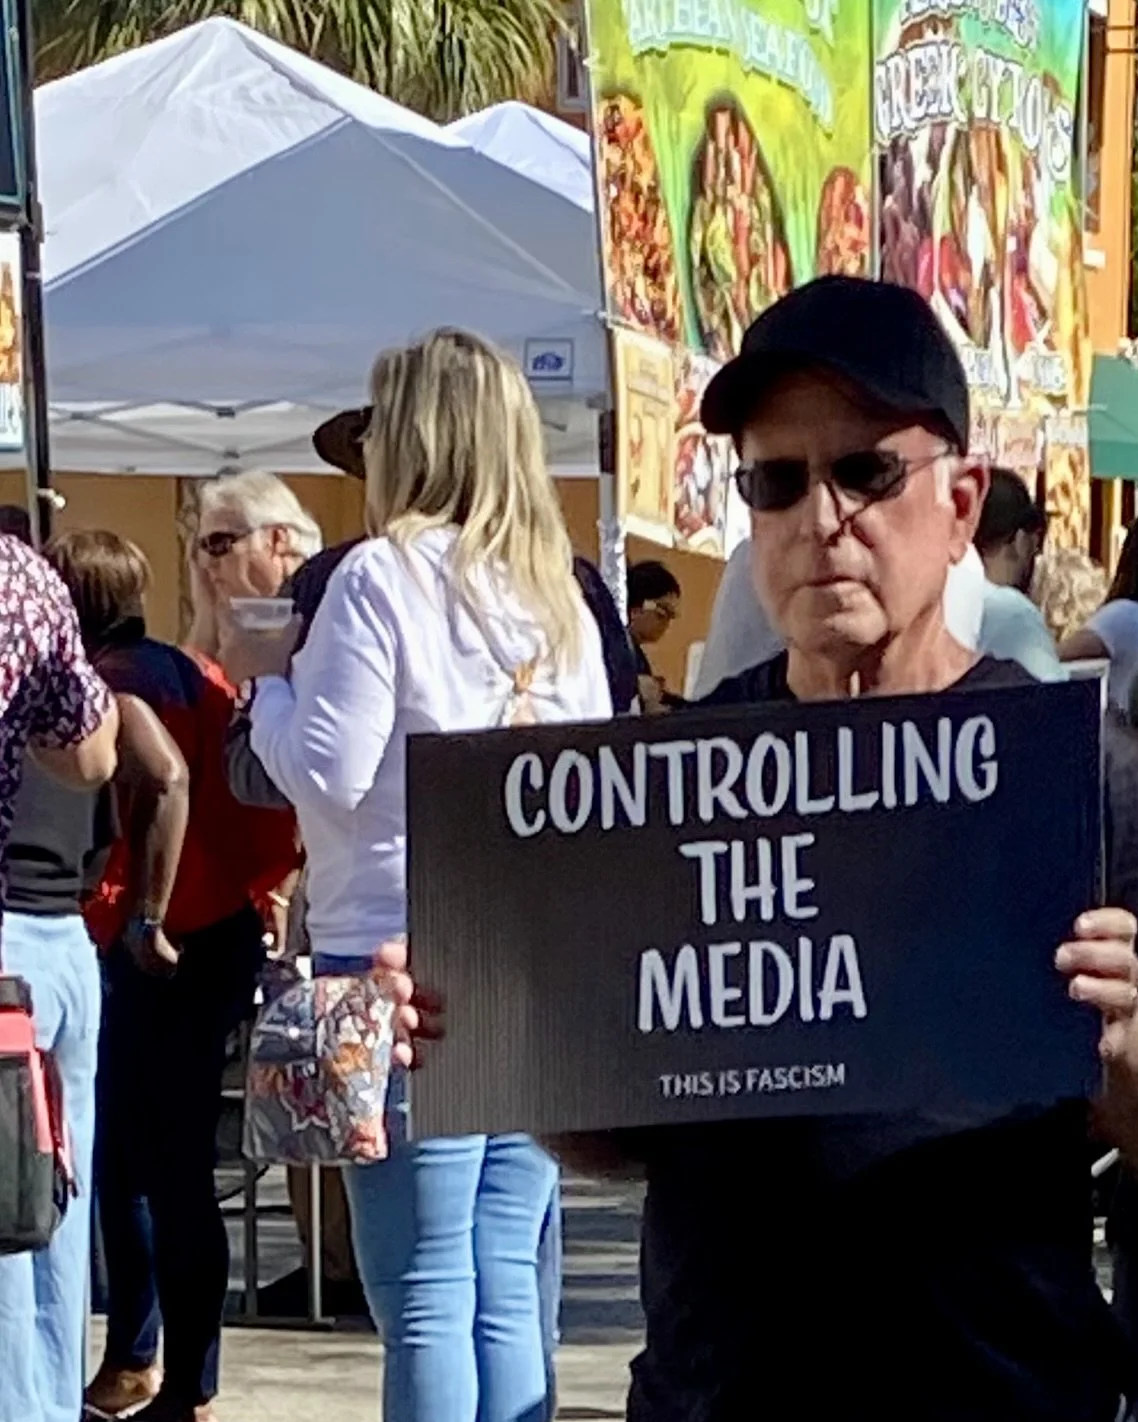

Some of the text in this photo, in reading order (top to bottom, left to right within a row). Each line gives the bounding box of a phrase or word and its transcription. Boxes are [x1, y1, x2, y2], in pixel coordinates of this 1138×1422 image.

[505, 715, 999, 837] CONTROLLING
[678, 833, 819, 925] THE
[638, 934, 868, 1033] MEDIA
[660, 1063, 846, 1097] THIS IS FASCISM
